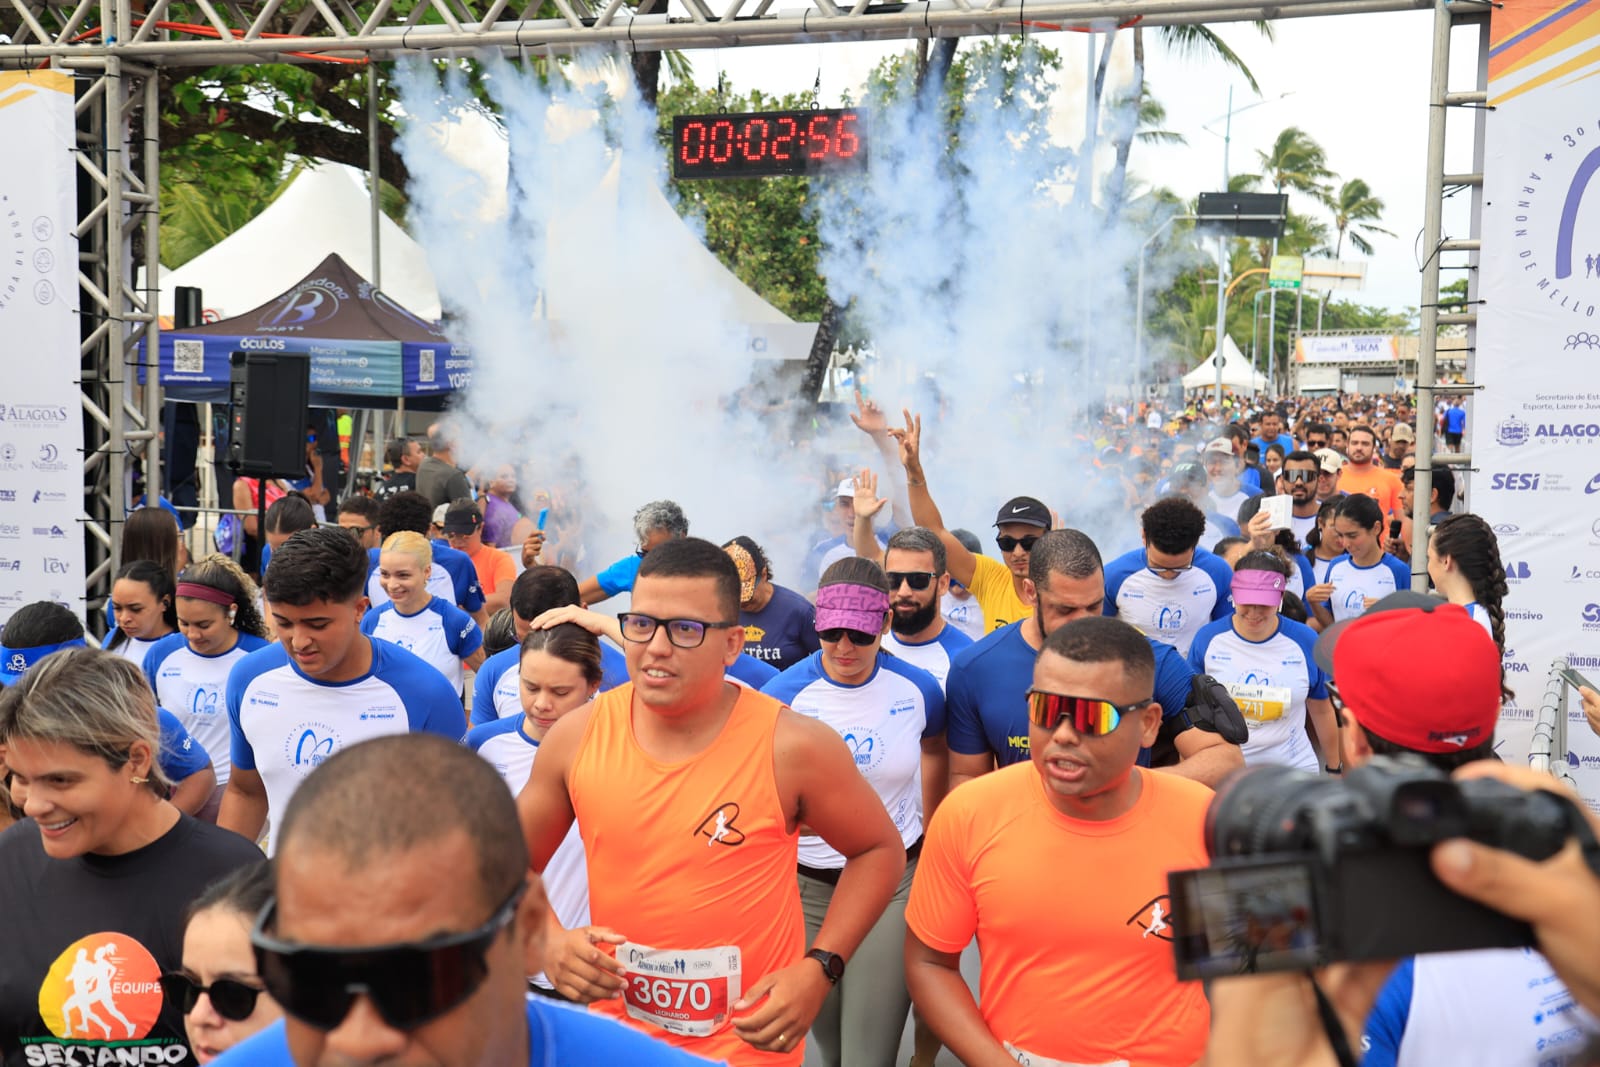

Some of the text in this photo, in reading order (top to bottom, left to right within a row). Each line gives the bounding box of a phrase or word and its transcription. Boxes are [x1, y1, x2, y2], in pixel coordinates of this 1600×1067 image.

[681, 115, 859, 164] 00:02:56
[1515, 172, 1595, 317] ARNON DE MELLO
[240, 337, 286, 350] ÓCULOS
[1535, 393, 1600, 401] Secretaria de Est
[7, 406, 68, 421] ALAGOAS
[1534, 424, 1600, 437] ALAGO
[1241, 700, 1265, 717] 711
[112, 981, 162, 995] EQUIPE
[632, 976, 711, 1011] 3670
[655, 1009, 690, 1020] LEONARDO
[24, 1043, 188, 1067] SEXTANDO
